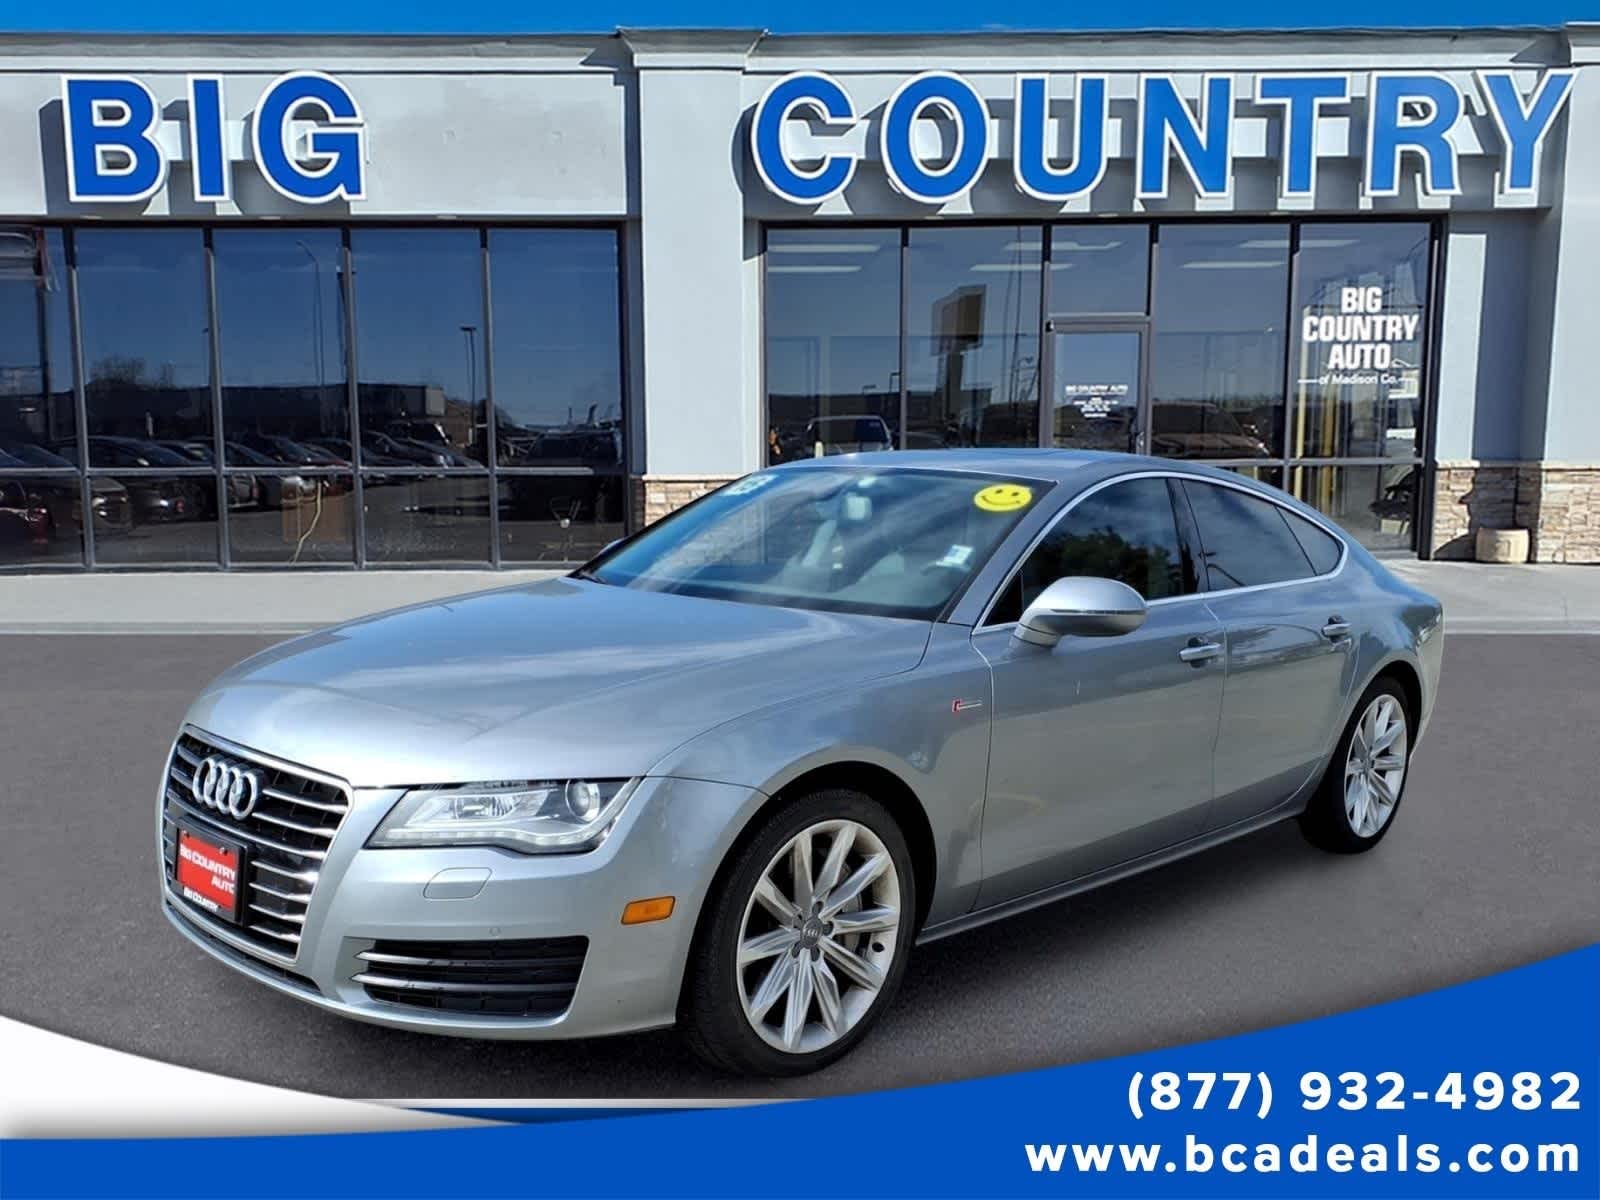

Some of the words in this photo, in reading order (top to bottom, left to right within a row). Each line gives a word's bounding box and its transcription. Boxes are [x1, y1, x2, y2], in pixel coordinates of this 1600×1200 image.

[61, 71, 366, 203] BIG
[751, 70, 1577, 204] COUNTRY
[1341, 286, 1382, 313] BIG
[1303, 314, 1419, 342] COUNTRY
[1328, 343, 1391, 370] AUTO
[1331, 373, 1378, 385] Madison
[192, 850, 236, 881] COUNTRY
